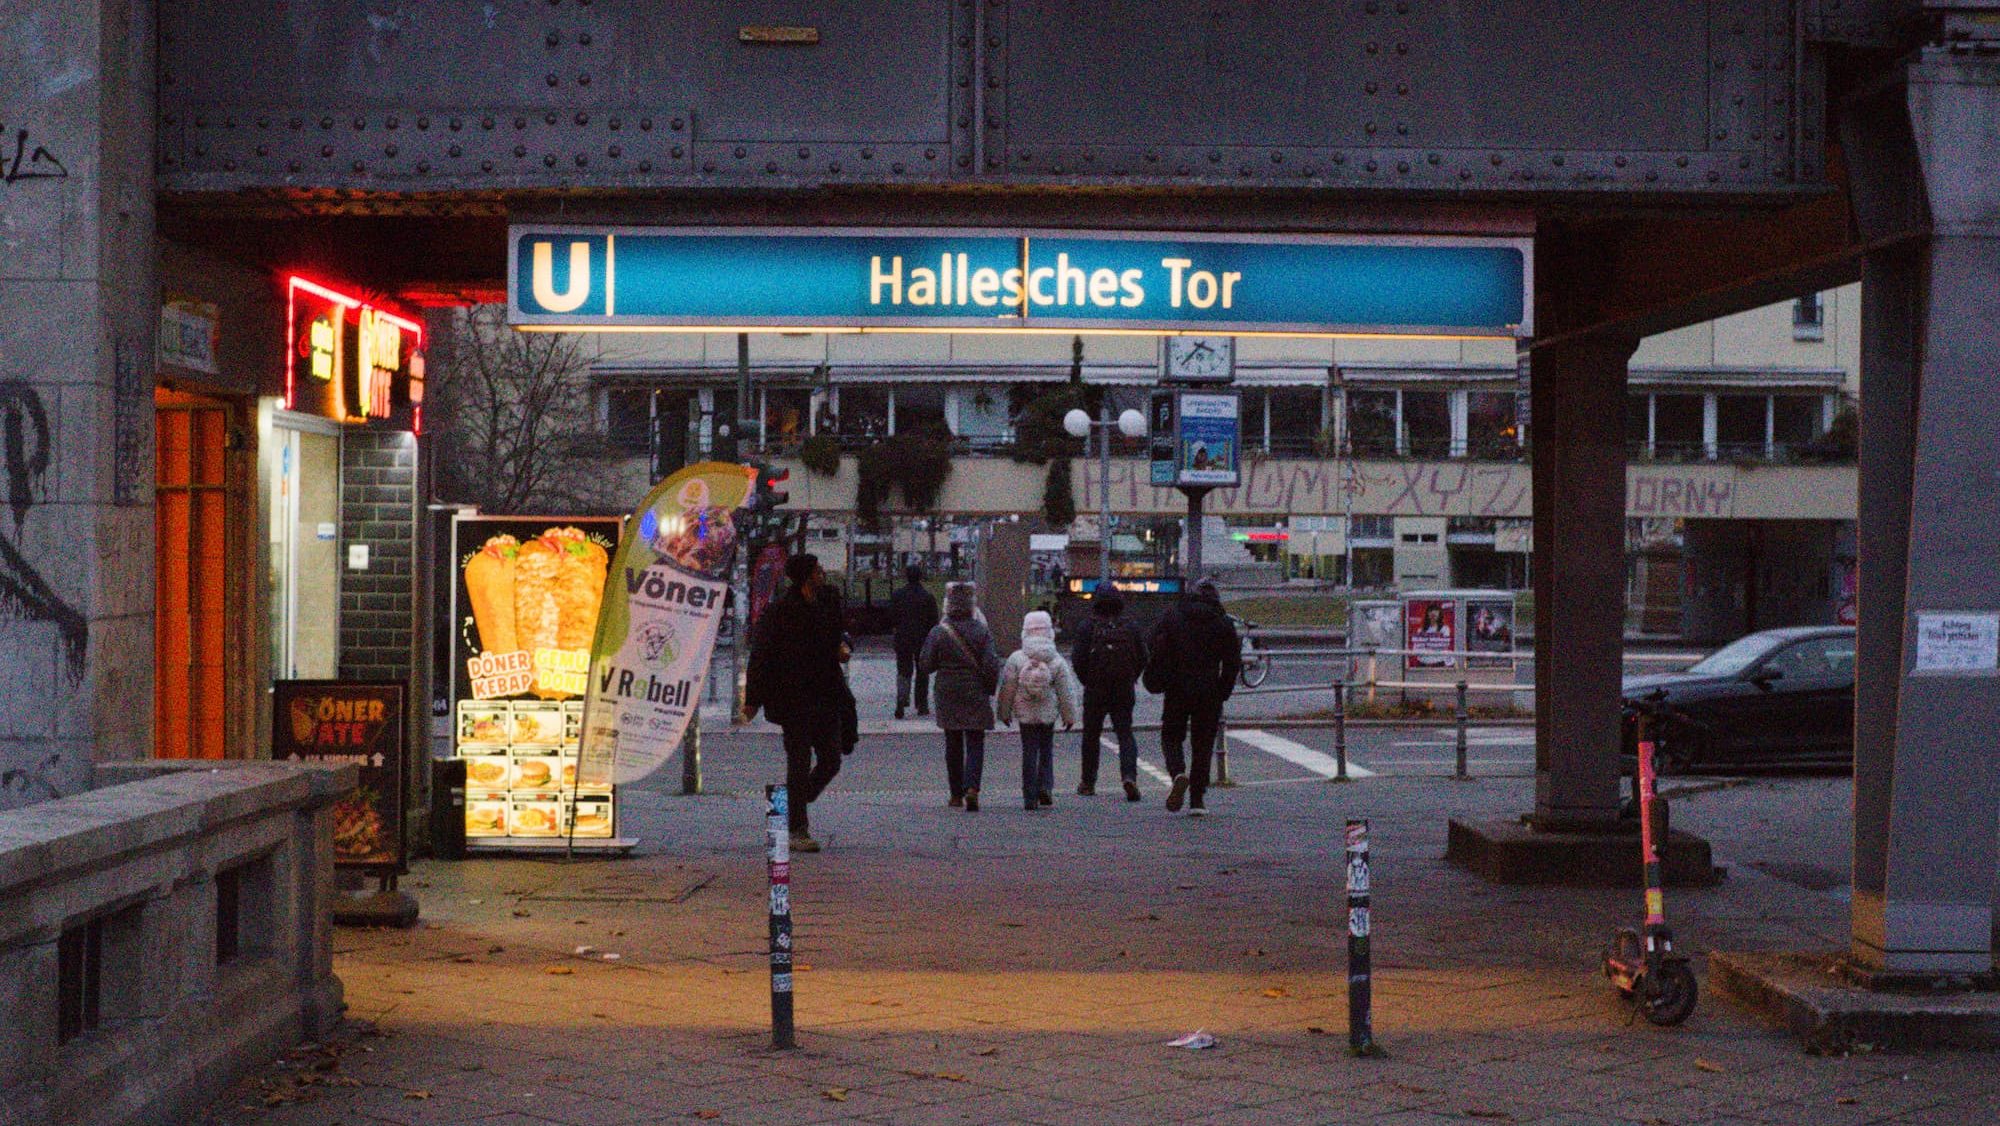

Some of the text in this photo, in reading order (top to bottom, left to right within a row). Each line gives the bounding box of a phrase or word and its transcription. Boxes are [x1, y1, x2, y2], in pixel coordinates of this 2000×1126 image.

[532, 241, 1242, 313] U Hallesches Tor
[625, 566, 721, 611] Vöner
[469, 652, 529, 676] DÖNER
[536, 648, 590, 671] GEMÜ
[473, 675, 532, 698] KEBAP
